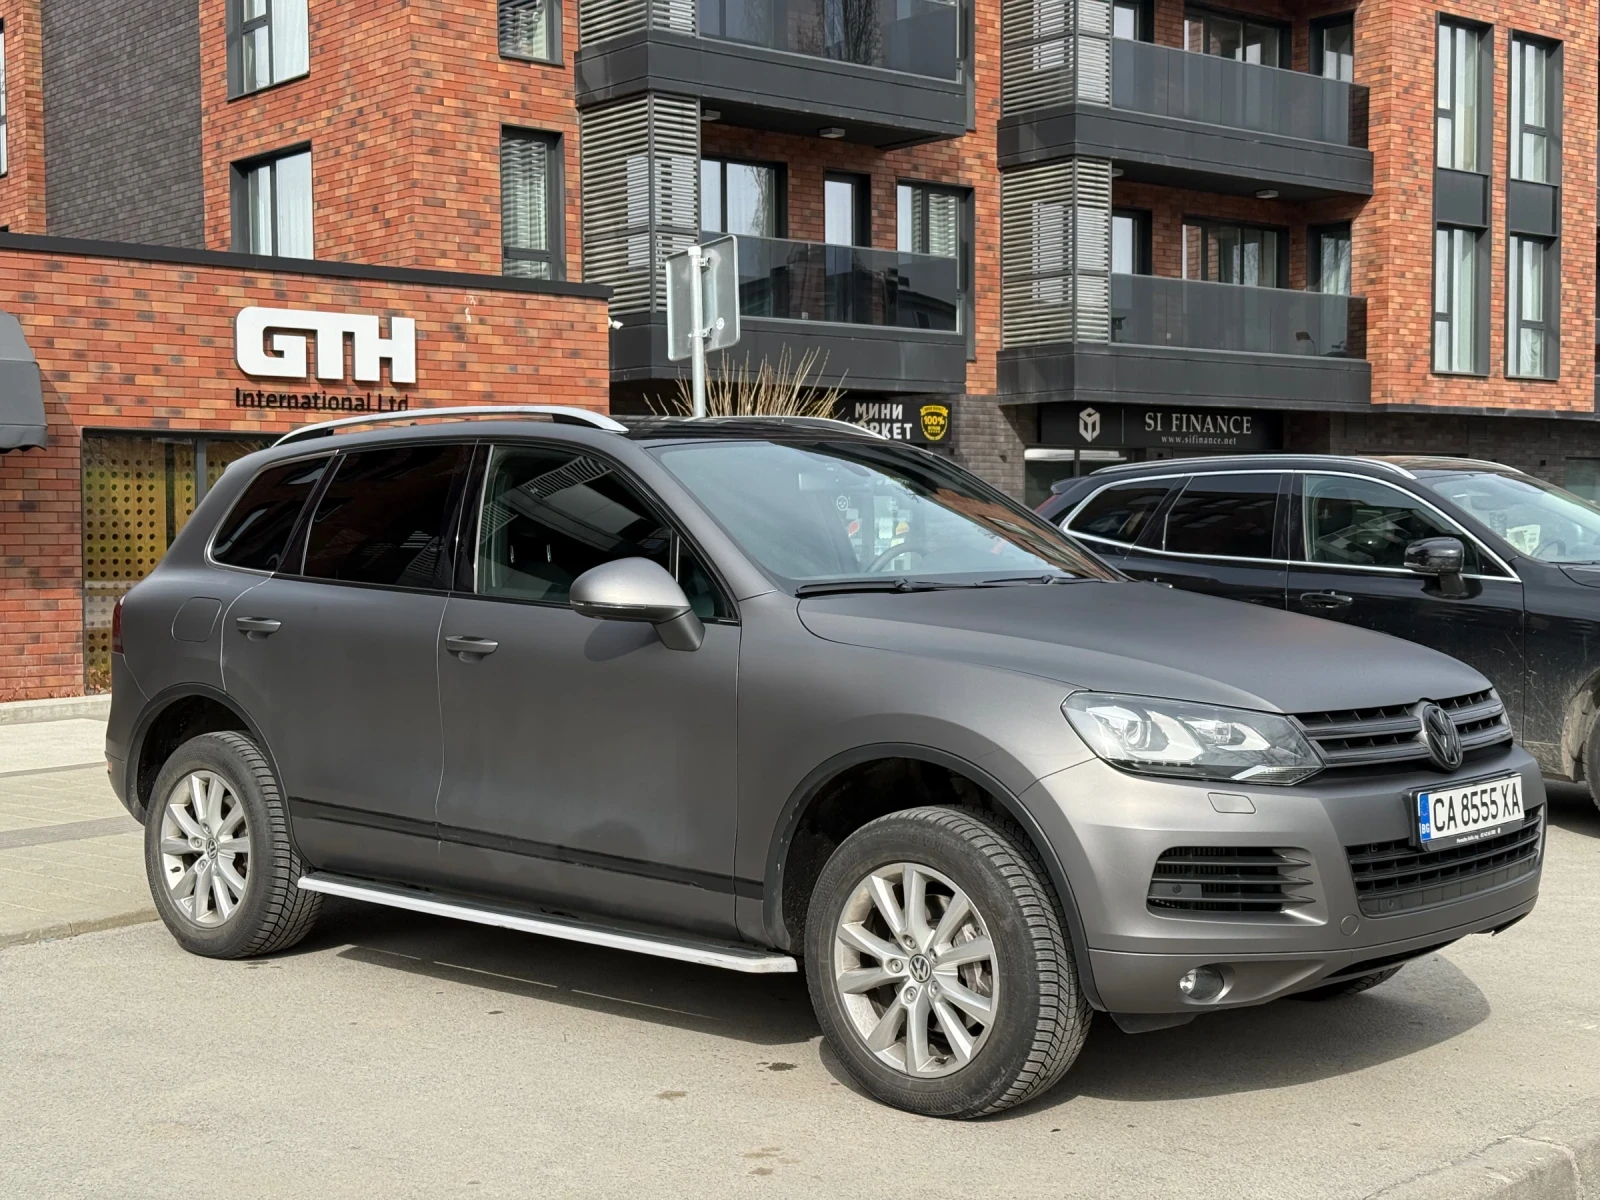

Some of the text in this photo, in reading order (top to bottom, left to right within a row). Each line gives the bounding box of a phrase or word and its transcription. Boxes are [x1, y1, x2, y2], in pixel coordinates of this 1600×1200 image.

[234, 306, 416, 384] GTH
[235, 387, 408, 413] International Ltd
[854, 402, 903, 420] МИНИ
[923, 415, 945, 425] 100%
[853, 422, 912, 440] РКЕТ
[1145, 412, 1252, 434] SI FINANCE
[1161, 435, 1237, 445] www.sifinance.net
[1433, 782, 1521, 832] CA 8555 XA
[1422, 823, 1430, 834] BG
